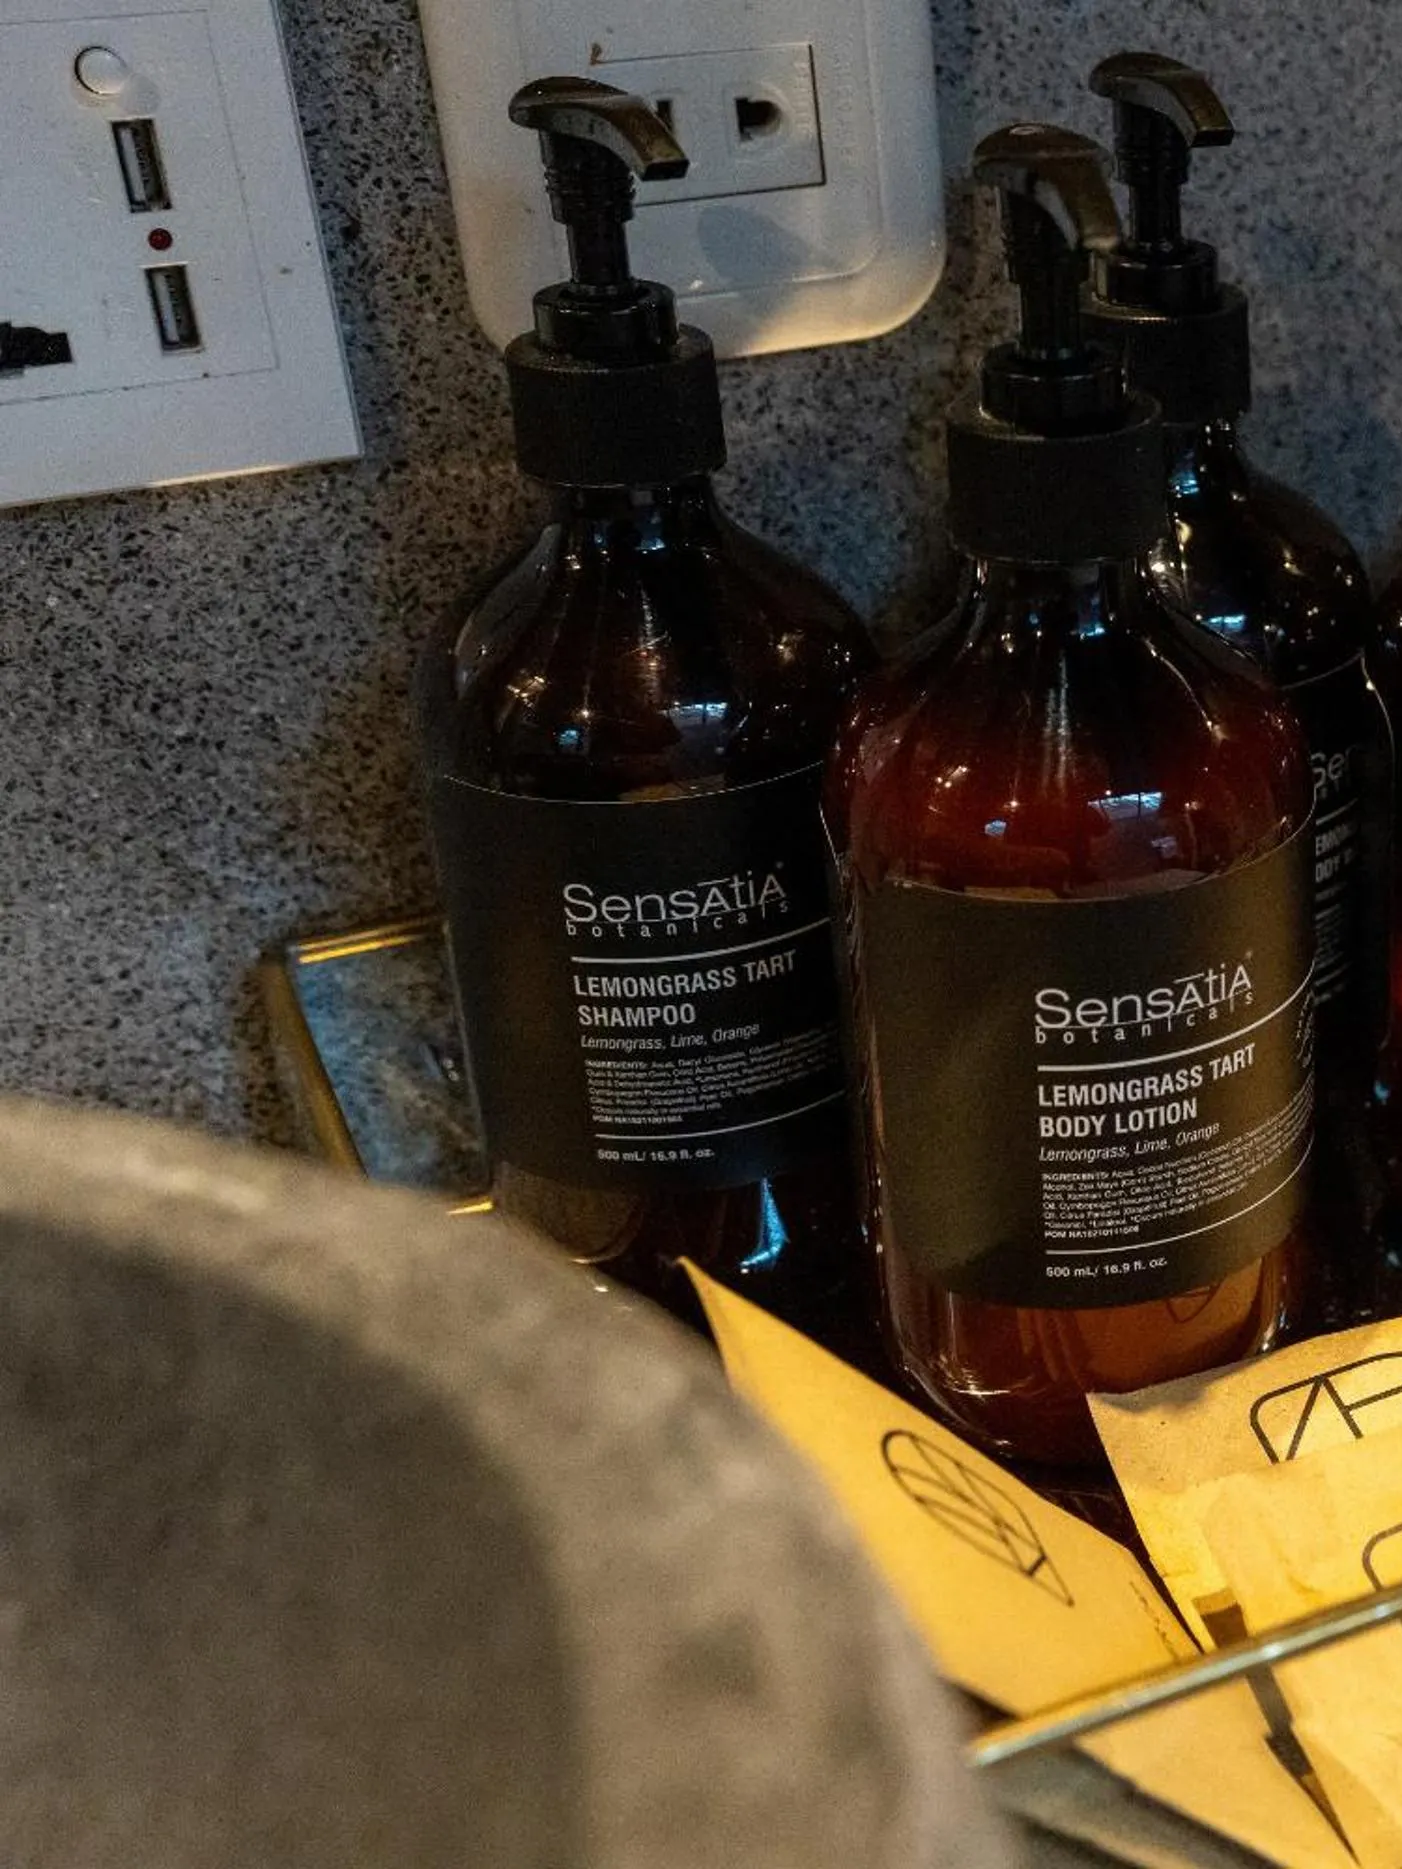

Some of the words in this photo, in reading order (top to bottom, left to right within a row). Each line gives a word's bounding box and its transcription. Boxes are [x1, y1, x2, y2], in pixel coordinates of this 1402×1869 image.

[566, 900, 788, 937] botanicals
[574, 966, 737, 998] LEMONGRASS
[744, 949, 797, 984] TART
[578, 1003, 696, 1027] SHAMPOO
[712, 1023, 760, 1044] Orange
[1035, 990, 1253, 1044] botanicals
[1038, 1065, 1203, 1107] LEMONGRASS
[1209, 1043, 1256, 1080] TART
[1039, 1114, 1106, 1137] BODY
[1115, 1097, 1198, 1134] LOTION
[1175, 1123, 1220, 1147] Orange
[1046, 1267, 1070, 1278] 500
[1104, 1262, 1131, 1276] 16.9
